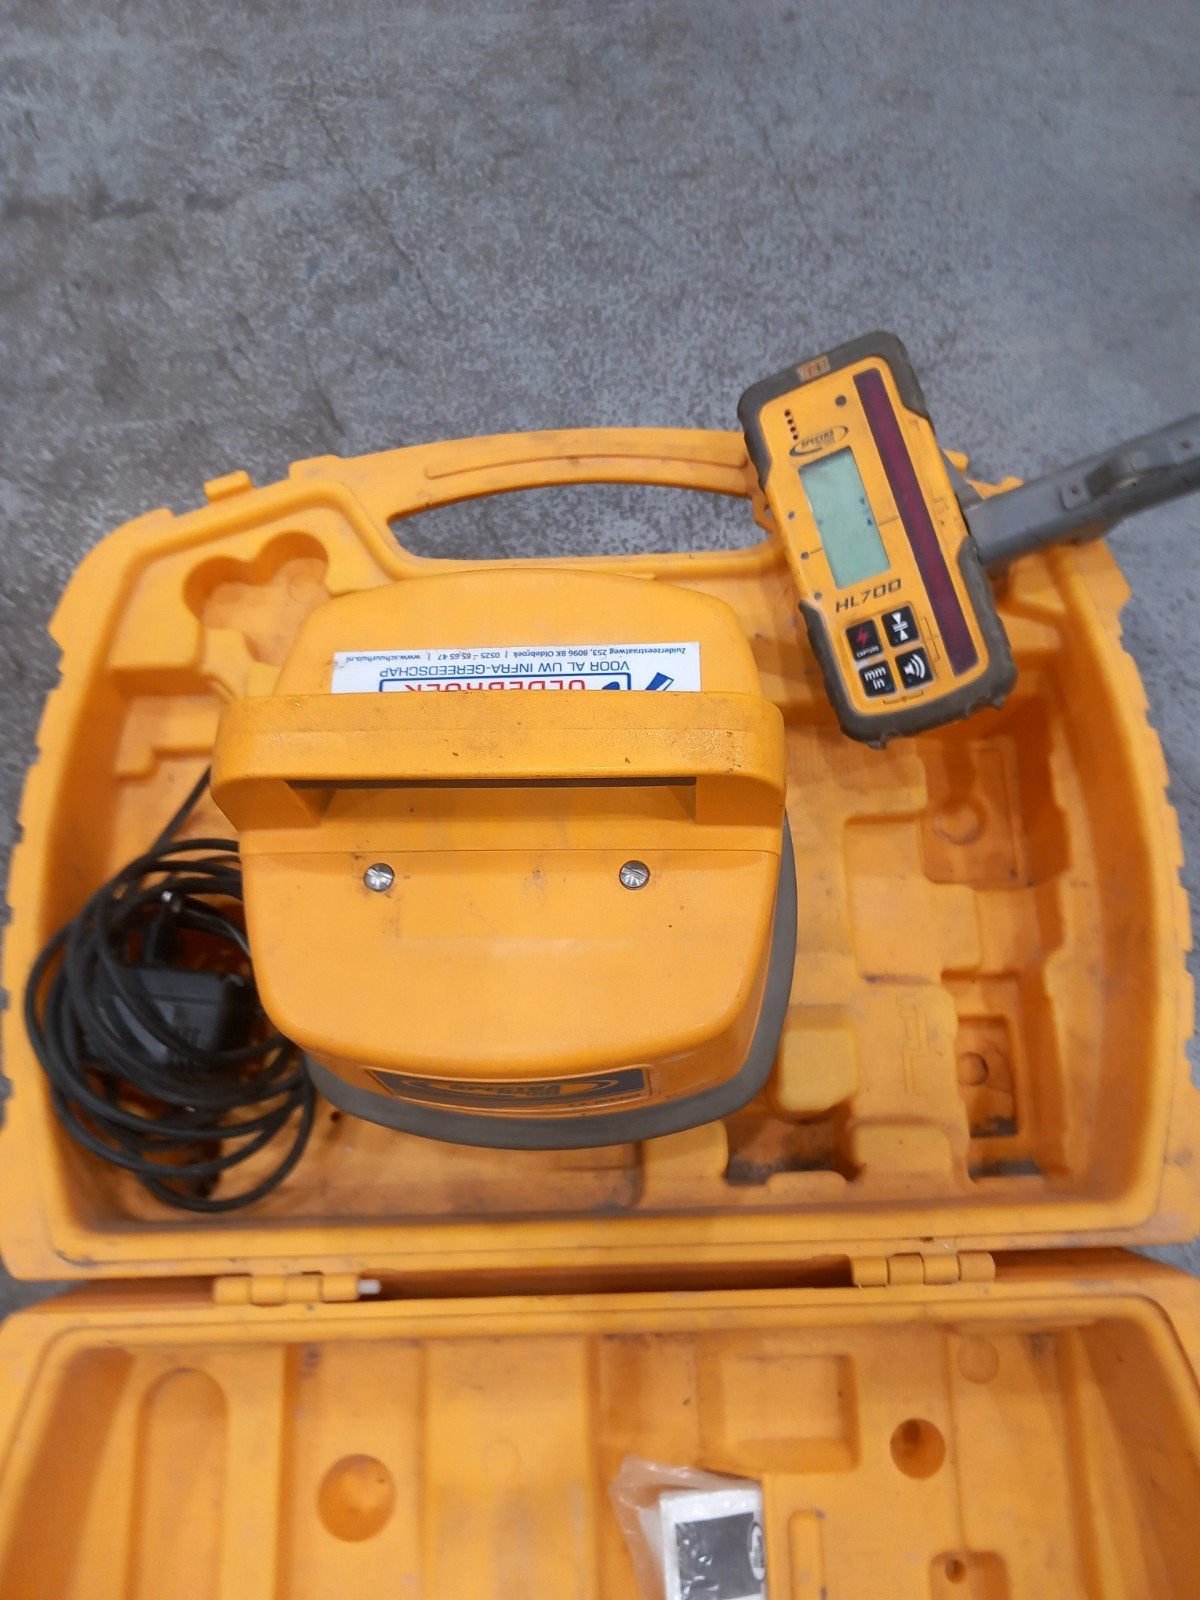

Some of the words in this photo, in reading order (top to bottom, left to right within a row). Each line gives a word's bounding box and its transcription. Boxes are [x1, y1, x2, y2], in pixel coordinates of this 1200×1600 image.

[835, 578, 902, 614] HL700
[480, 651, 500, 659] 0525
[512, 650, 554, 659] Oldebroek
[569, 649, 588, 657] 8096
[609, 647, 687, 656] Zuiderzeestraatweg
[379, 663, 533, 678] INFRA-GEREEDSCHAP
[538, 662, 562, 673] UW
[567, 661, 586, 672] AL
[590, 660, 630, 672] VOOR
[864, 666, 887, 682] mm
